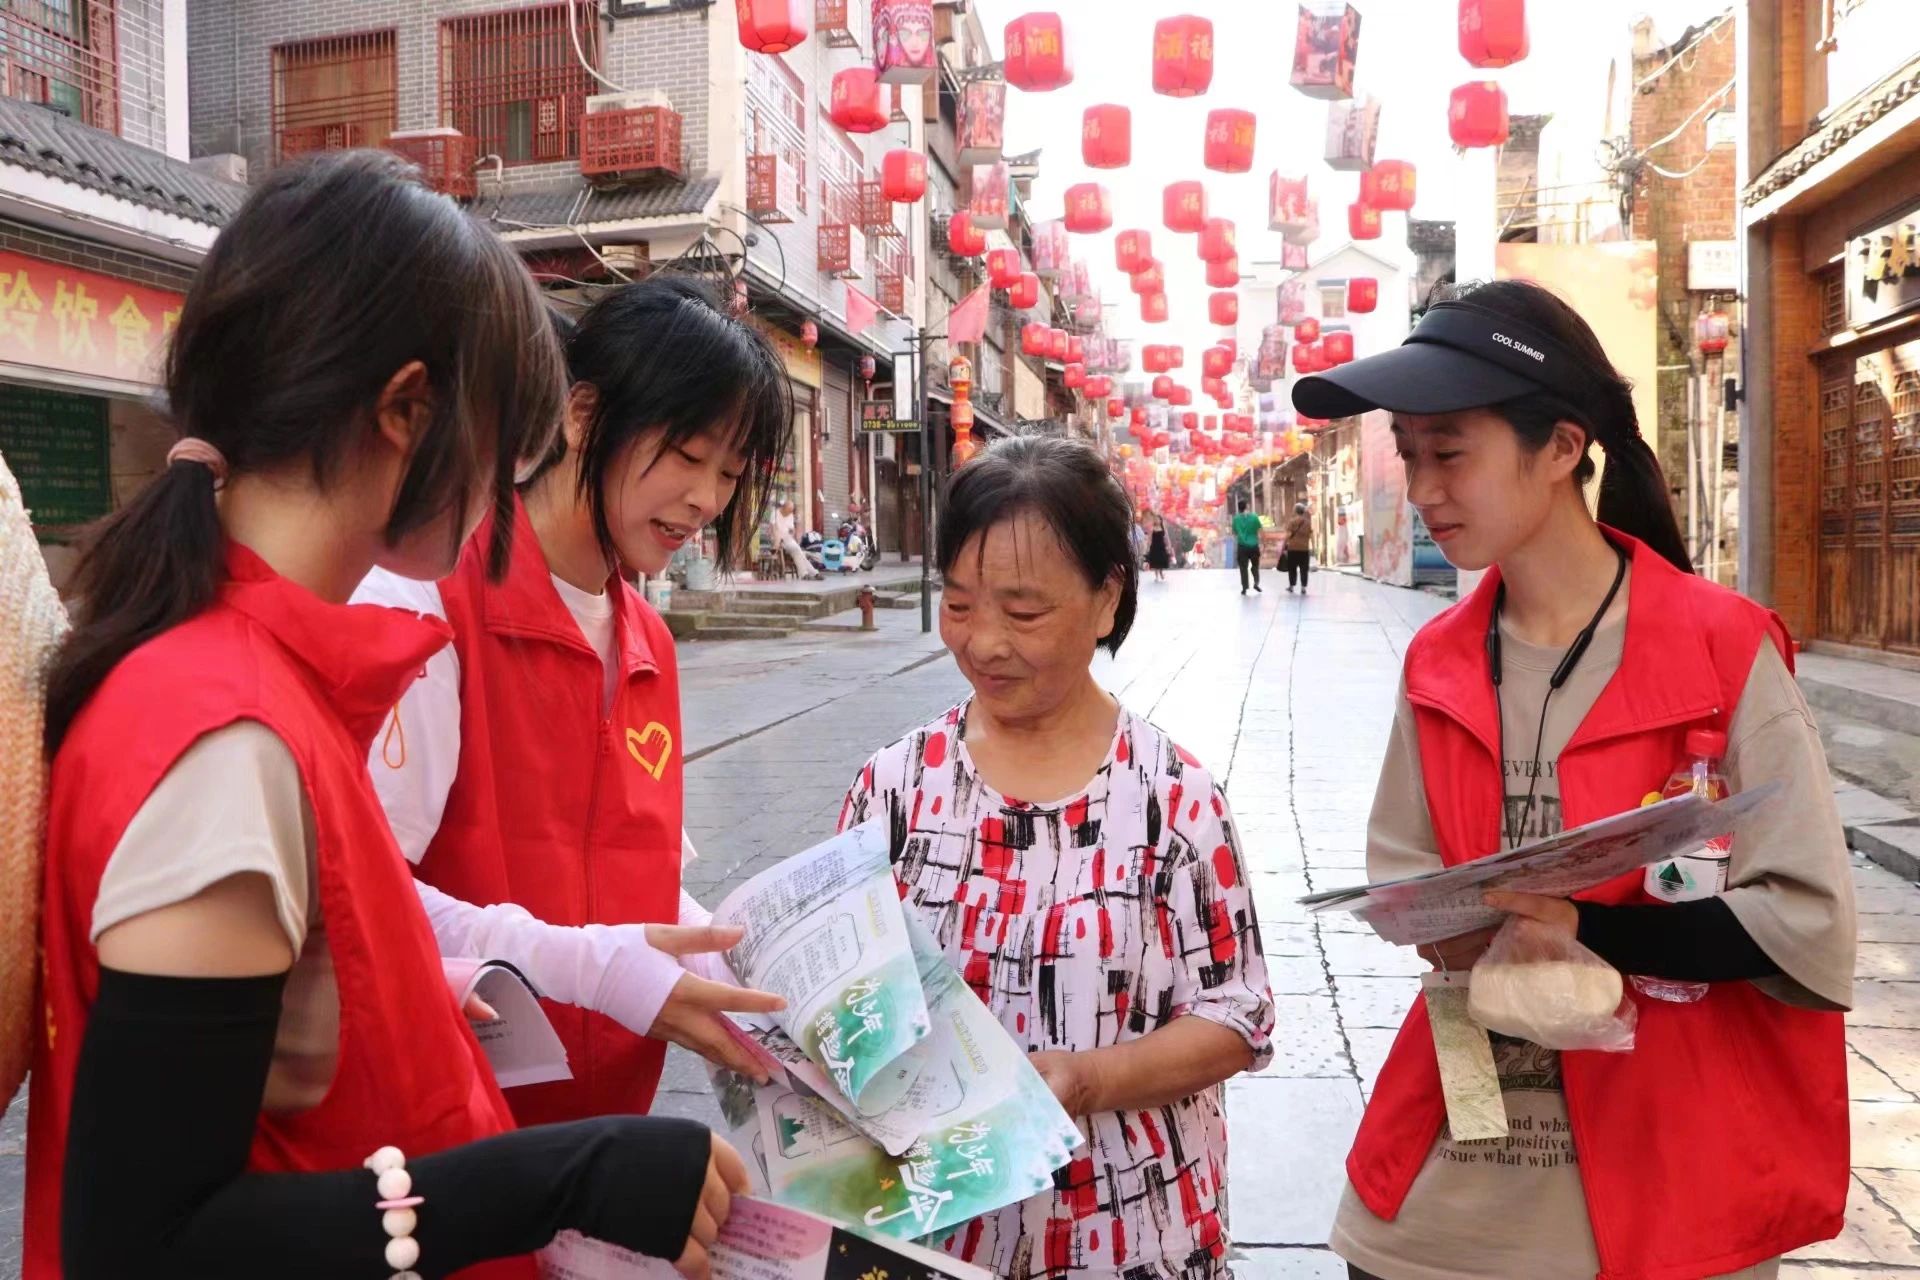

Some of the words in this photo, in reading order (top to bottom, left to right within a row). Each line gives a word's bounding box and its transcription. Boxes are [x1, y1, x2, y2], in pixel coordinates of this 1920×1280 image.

[0, 269, 184, 368] 玲饮食
[1492, 332, 1513, 347] COOL
[1512, 341, 1545, 363] SUMMER
[945, 1121, 994, 1180] 为少年
[1506, 1134, 1569, 1150] positive
[1483, 1148, 1522, 1166] what
[1528, 1152, 1559, 1168] will
